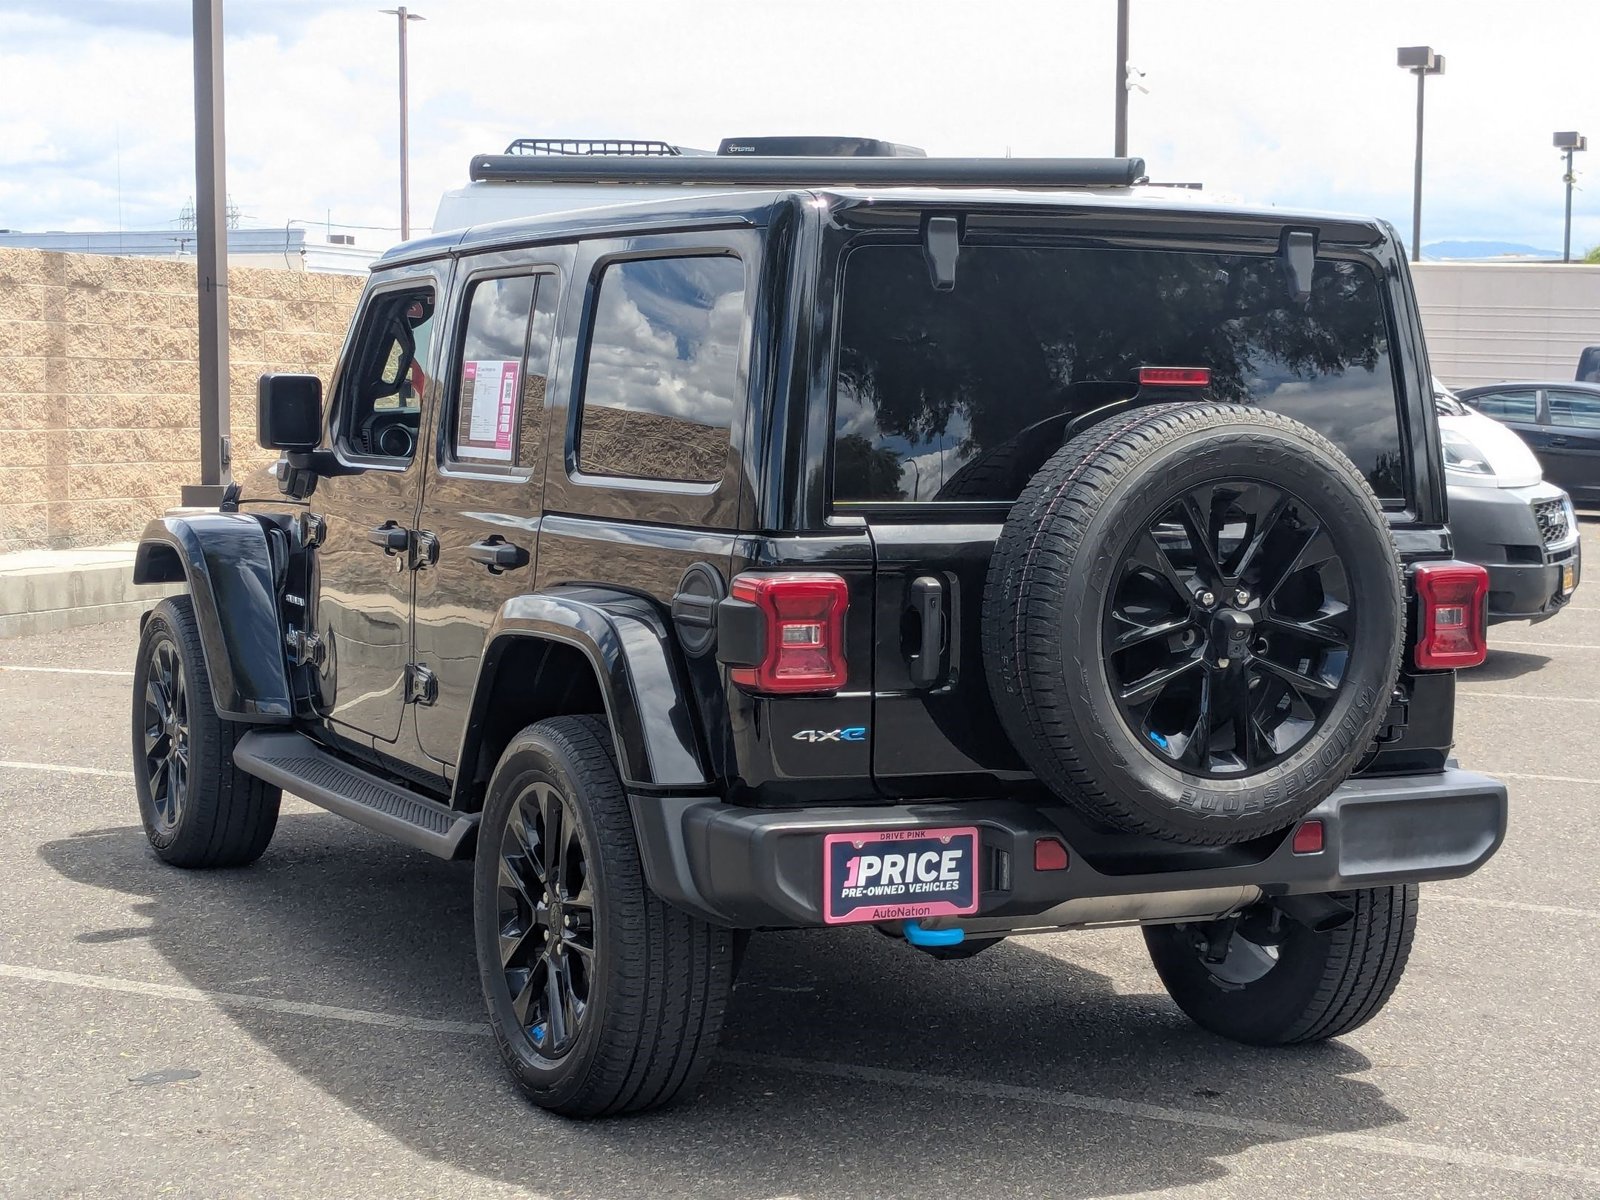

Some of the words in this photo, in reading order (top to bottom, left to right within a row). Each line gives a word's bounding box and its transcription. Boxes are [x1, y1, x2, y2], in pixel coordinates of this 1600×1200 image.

[880, 832, 904, 840] DRIVE
[907, 830, 926, 839] PINK
[841, 885, 905, 898] PRE-OWNED
[909, 880, 959, 893] VEHICLES
[872, 906, 930, 919] AutoNation
